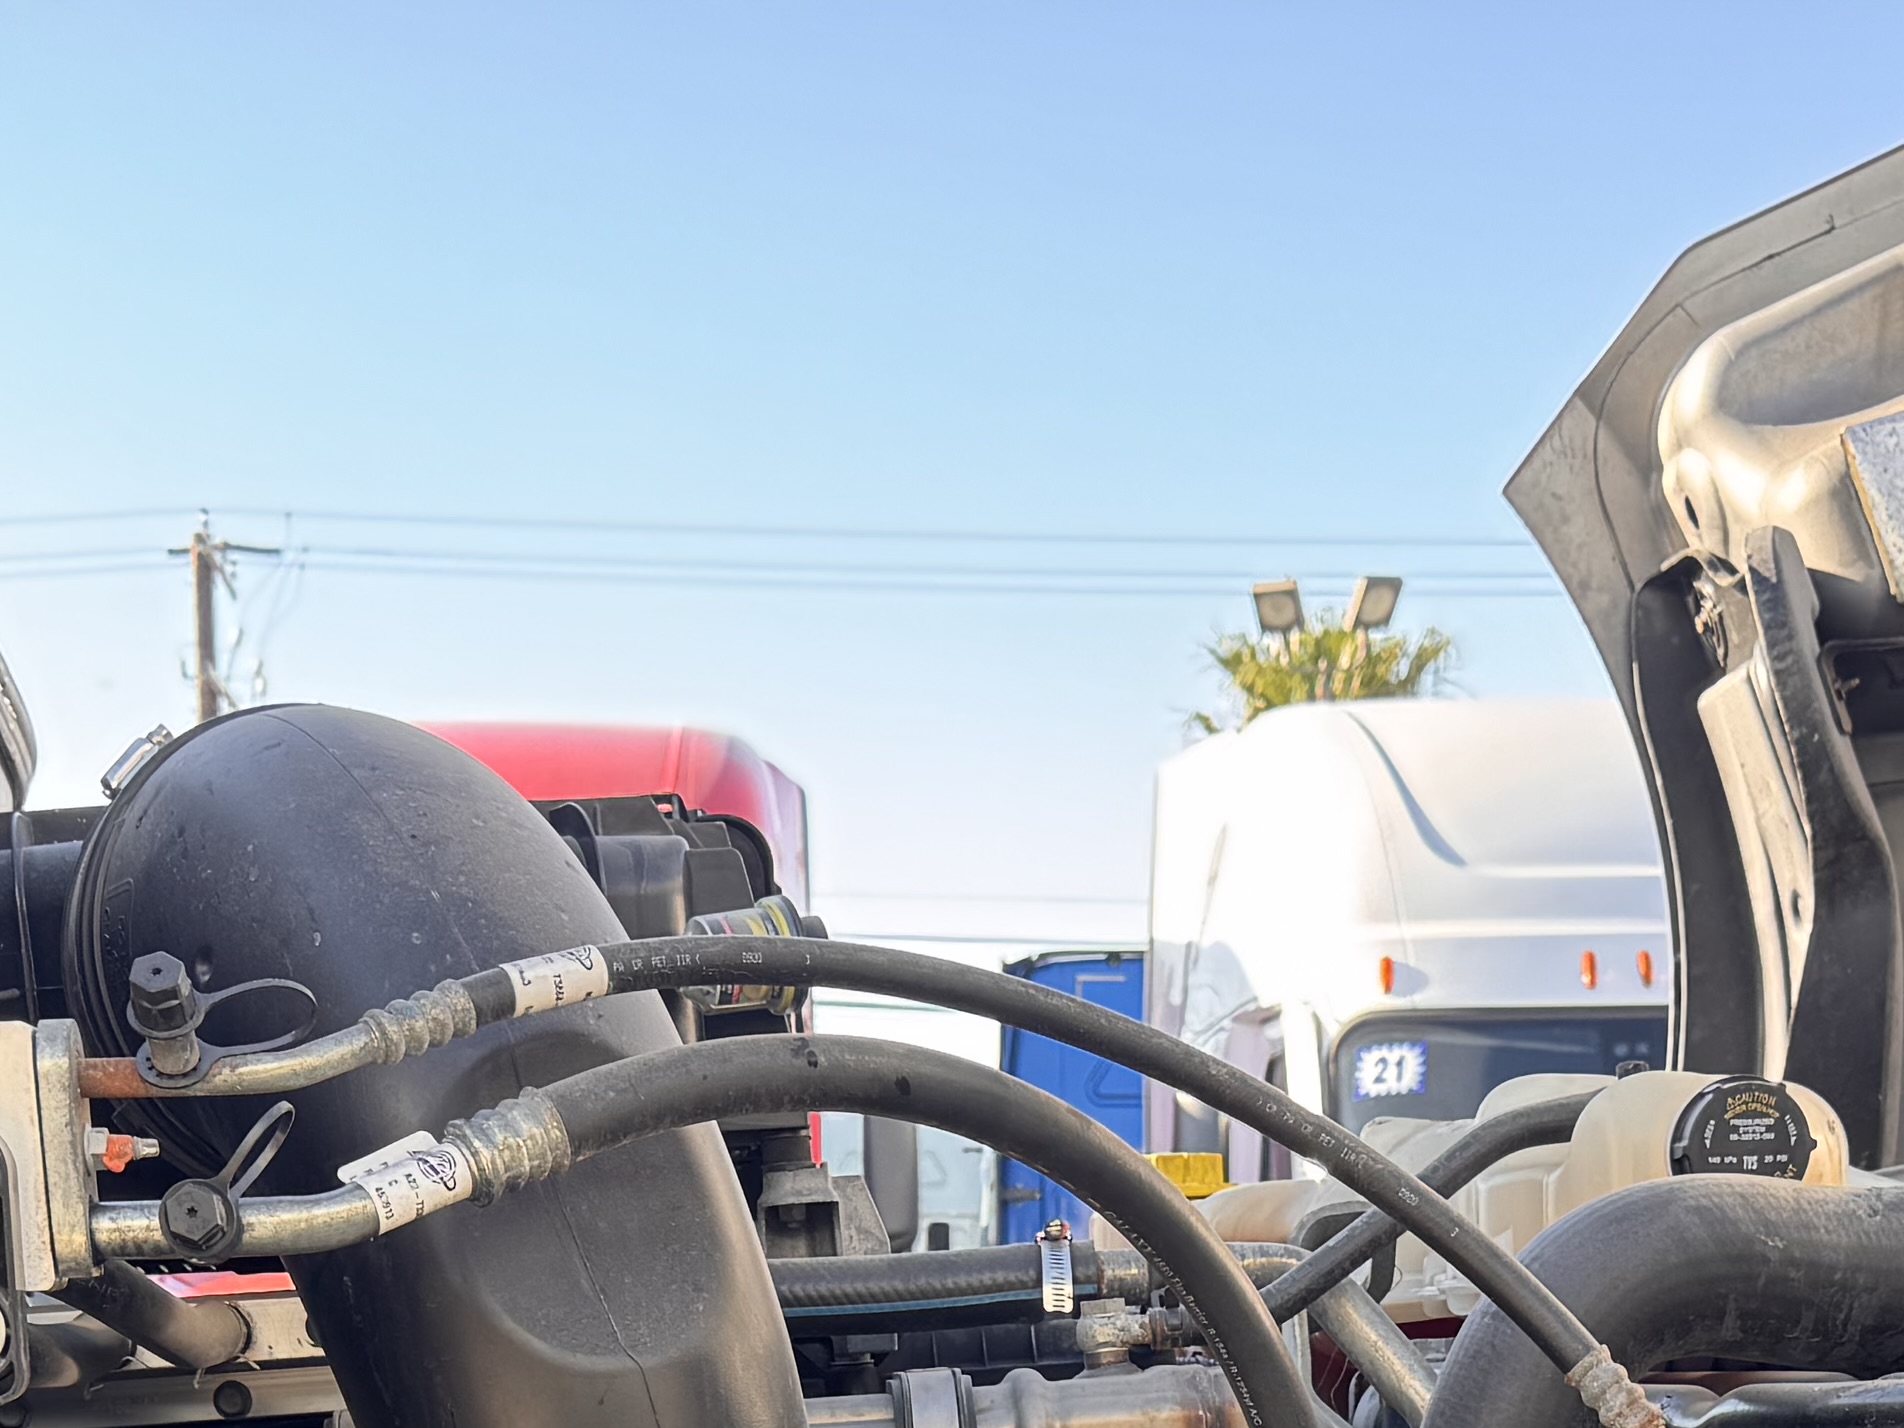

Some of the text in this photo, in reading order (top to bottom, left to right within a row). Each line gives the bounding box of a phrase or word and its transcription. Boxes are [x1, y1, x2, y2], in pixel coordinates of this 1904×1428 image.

[1373, 1055, 1407, 1085] 21
[1734, 1091, 1777, 1108] CAUTION
[1248, 1407, 1263, 1427] A/C
